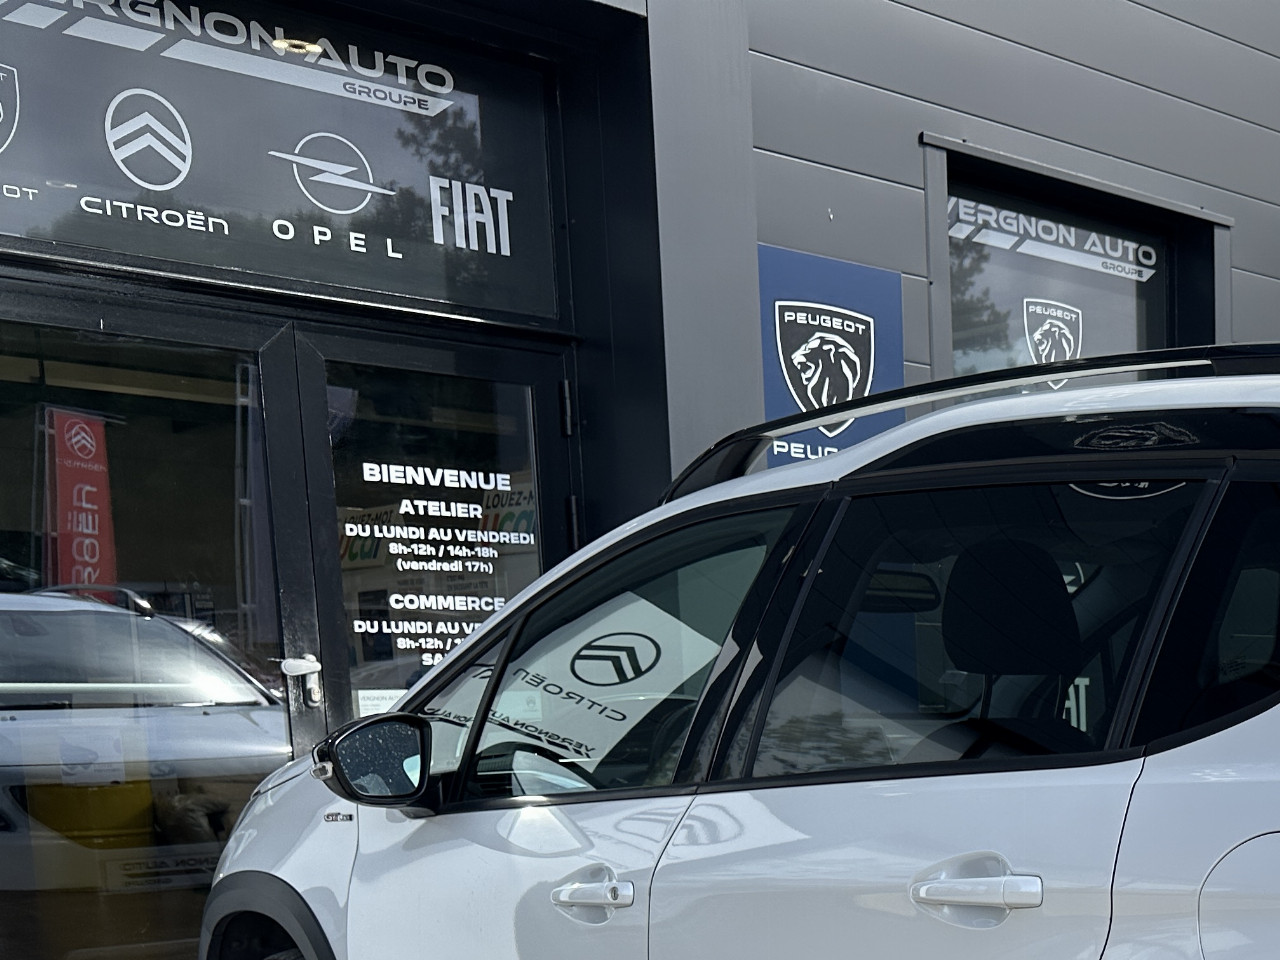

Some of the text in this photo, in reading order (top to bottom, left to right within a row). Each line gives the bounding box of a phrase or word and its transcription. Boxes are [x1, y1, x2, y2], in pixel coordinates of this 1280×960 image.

[40, 0, 454, 94] GNON AUTO
[343, 81, 430, 111] GROUPE
[429, 176, 514, 257] FIAT
[272, 219, 403, 259] OPEL
[1083, 232, 1157, 266] AUTO
[1101, 261, 1144, 278] GROUPE
[784, 311, 866, 335] PEUGEOT
[1028, 305, 1077, 322] PEUGEOT
[362, 462, 511, 491] BIENVENUE
[399, 499, 483, 518] ATELIER
[345, 523, 535, 545] DU LUNDI AU VENDREDI
[389, 543, 436, 555] 8h-12h
[447, 545, 499, 558] 14h-18h
[396, 558, 494, 574] (vendredi 17h)
[389, 594, 506, 611] COMMERCE
[354, 620, 379, 633] DU
[382, 621, 433, 634] LUNDI
[436, 621, 459, 634] AU
[397, 638, 443, 650] 8h-12h
